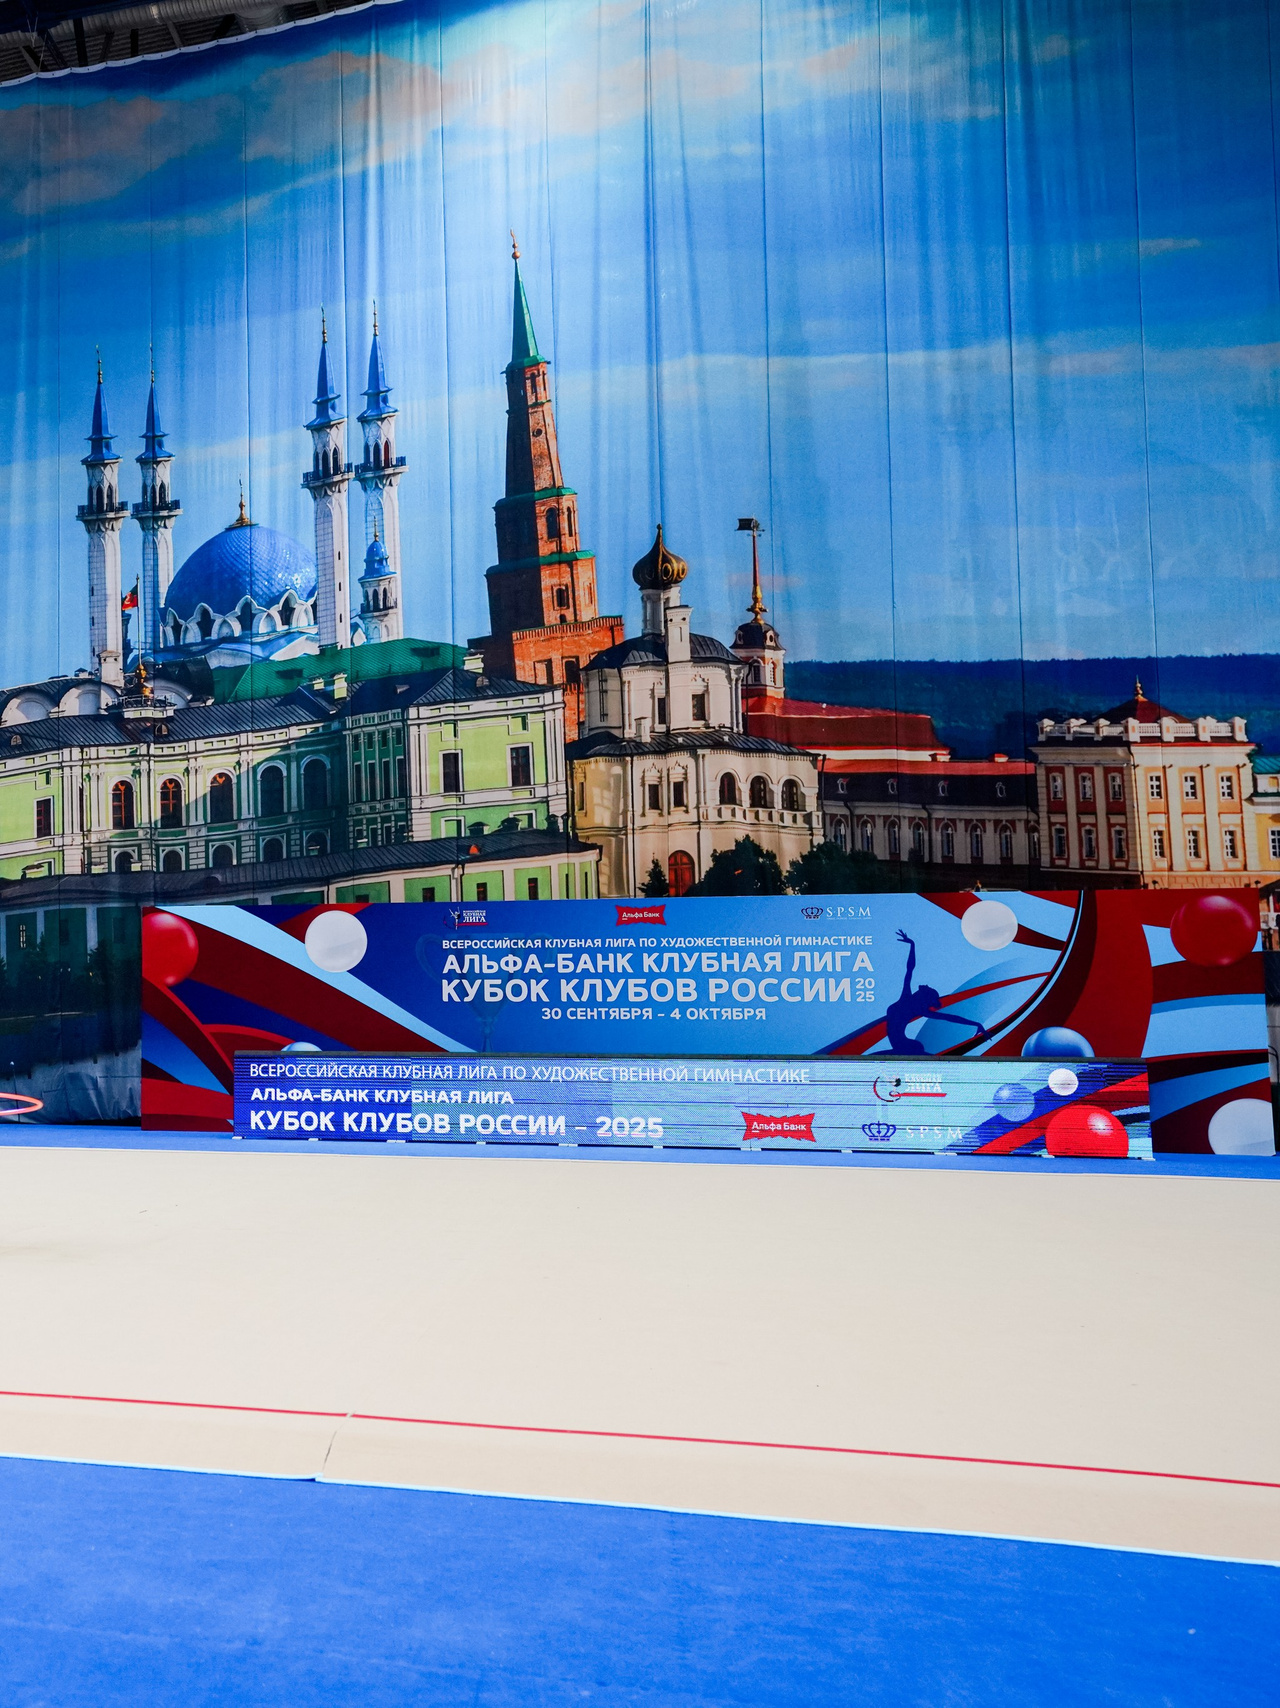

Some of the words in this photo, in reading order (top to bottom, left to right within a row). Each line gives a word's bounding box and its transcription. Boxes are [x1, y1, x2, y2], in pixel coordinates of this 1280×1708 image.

[622, 912, 643, 920] Альфа
[442, 937, 542, 949] ВСЕРОССИЙСКАЯ
[544, 938, 602, 948] КЛУБНАЯ
[604, 938, 636, 948] ЛИГА
[640, 938, 657, 947] ПО
[660, 934, 782, 948] ХУДОЖЕСТВЕННОЙ
[785, 935, 873, 946] ГИМНАСТИКЕ
[442, 953, 634, 974] АЛЬФА-БАНК
[642, 952, 782, 973] КЛУБНАЯ
[791, 951, 874, 972] ЛИГА
[442, 978, 550, 1003] КУБОК
[560, 978, 698, 1002] КЛУБОВ
[708, 977, 851, 1002] РОССИИ
[855, 978, 876, 989] 20
[855, 990, 875, 1002] 25
[541, 1007, 562, 1020] 30
[566, 1008, 653, 1020] СЕНТЯБРЯ
[670, 1008, 682, 1020] 4
[686, 1008, 766, 1020] ОКТЯБРЯ
[250, 1062, 378, 1078] ВСЕРОССИЙСКАЯ
[383, 1065, 453, 1079] КЛУБНАЯ
[458, 1066, 496, 1080] ЛИГА
[503, 1067, 526, 1080] ПО
[532, 1065, 688, 1083] ХУДОЖЕСТВЕННОЙ
[694, 1068, 810, 1083] ГИМНАСТИКЕ
[250, 1087, 369, 1102] АЛЬФА-БАНК
[374, 1089, 462, 1104] КЛУБНАЯ
[467, 1090, 514, 1105] ЛИГА
[250, 1110, 335, 1132] КУБОК
[343, 1112, 451, 1134] КЛУБОВ
[459, 1113, 566, 1136] РОССИИ
[595, 1116, 664, 1138] 2025
[752, 1121, 782, 1132] Альфа
[783, 1122, 806, 1131] Банк
